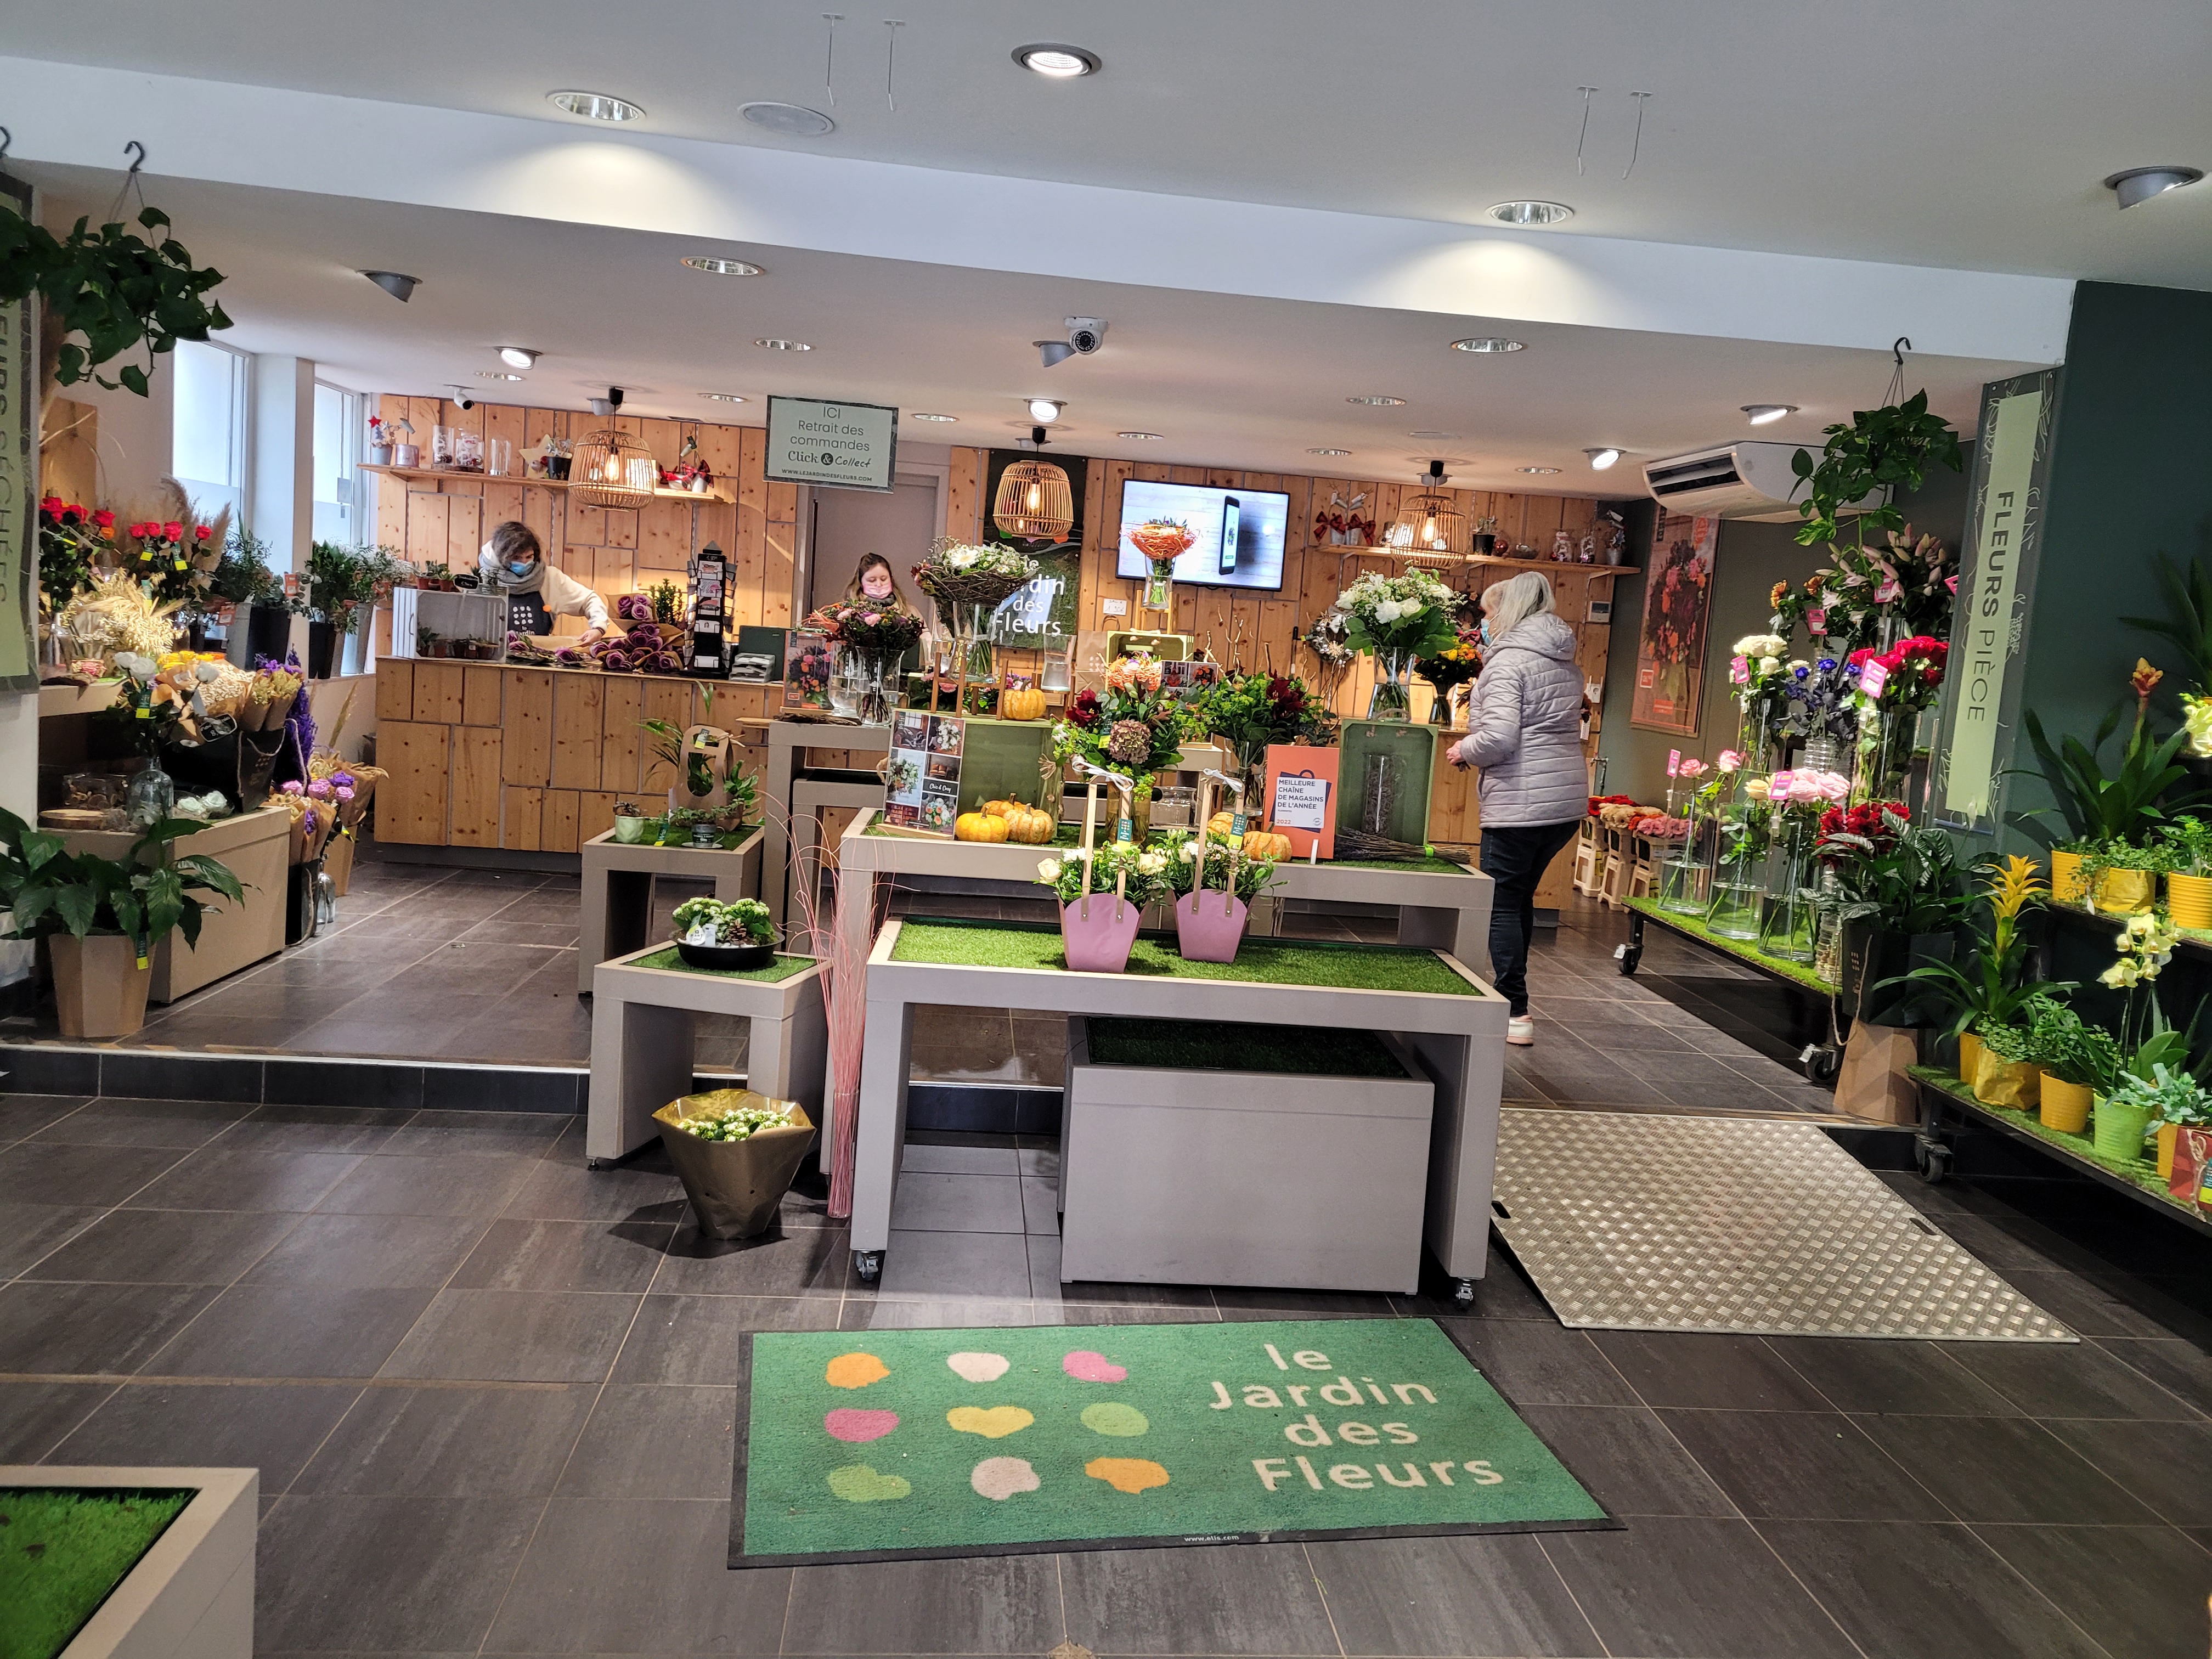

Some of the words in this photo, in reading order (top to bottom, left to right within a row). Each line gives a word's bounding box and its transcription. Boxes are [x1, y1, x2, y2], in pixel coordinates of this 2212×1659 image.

[823, 407, 840, 419] ICI
[798, 420, 838, 434] Retrait
[842, 424, 864, 436] des
[790, 436, 870, 452] commandes
[788, 450, 819, 464] Click
[822, 453, 833, 465] &
[835, 455, 871, 468] Collect
[782, 469, 872, 482] WWW.LEJARDINDESFLEURS.COM
[1982, 492, 2015, 617] FLEURS
[1020, 573, 1064, 595] din
[1013, 595, 1043, 613] des
[996, 612, 1062, 635] Fleurs
[1967, 630, 1996, 722] PIÈCE
[1263, 1344, 1333, 1371] le
[1209, 1376, 1438, 1409] Jardin
[1284, 1414, 1419, 1447] des
[1251, 1455, 1504, 1492] Fleurs
